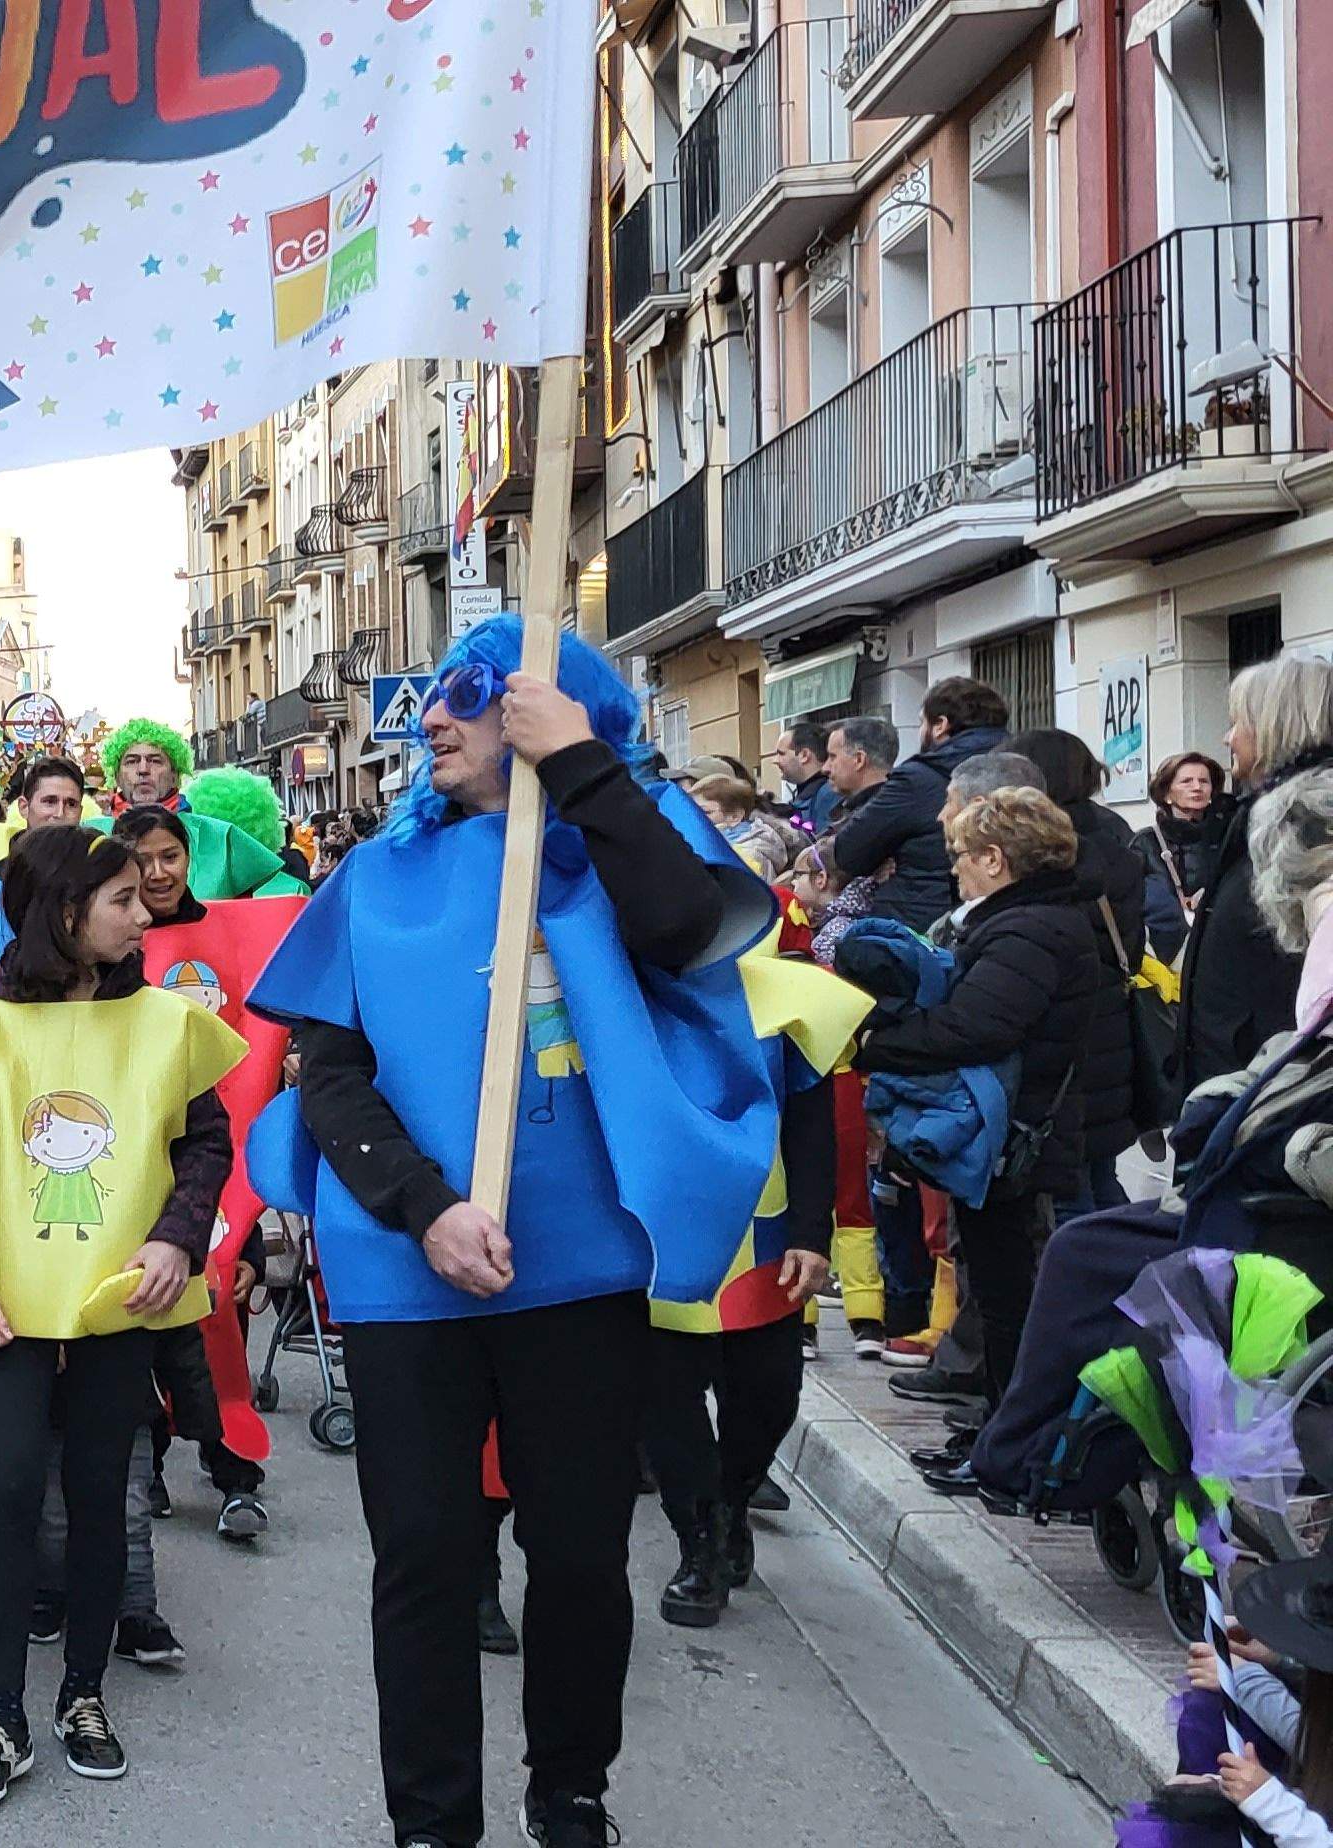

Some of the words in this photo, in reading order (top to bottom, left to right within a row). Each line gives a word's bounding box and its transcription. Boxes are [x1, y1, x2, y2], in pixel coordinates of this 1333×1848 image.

[275, 228, 326, 272] ce
[301, 304, 351, 347] HUESCA
[1104, 677, 1141, 740] APP
